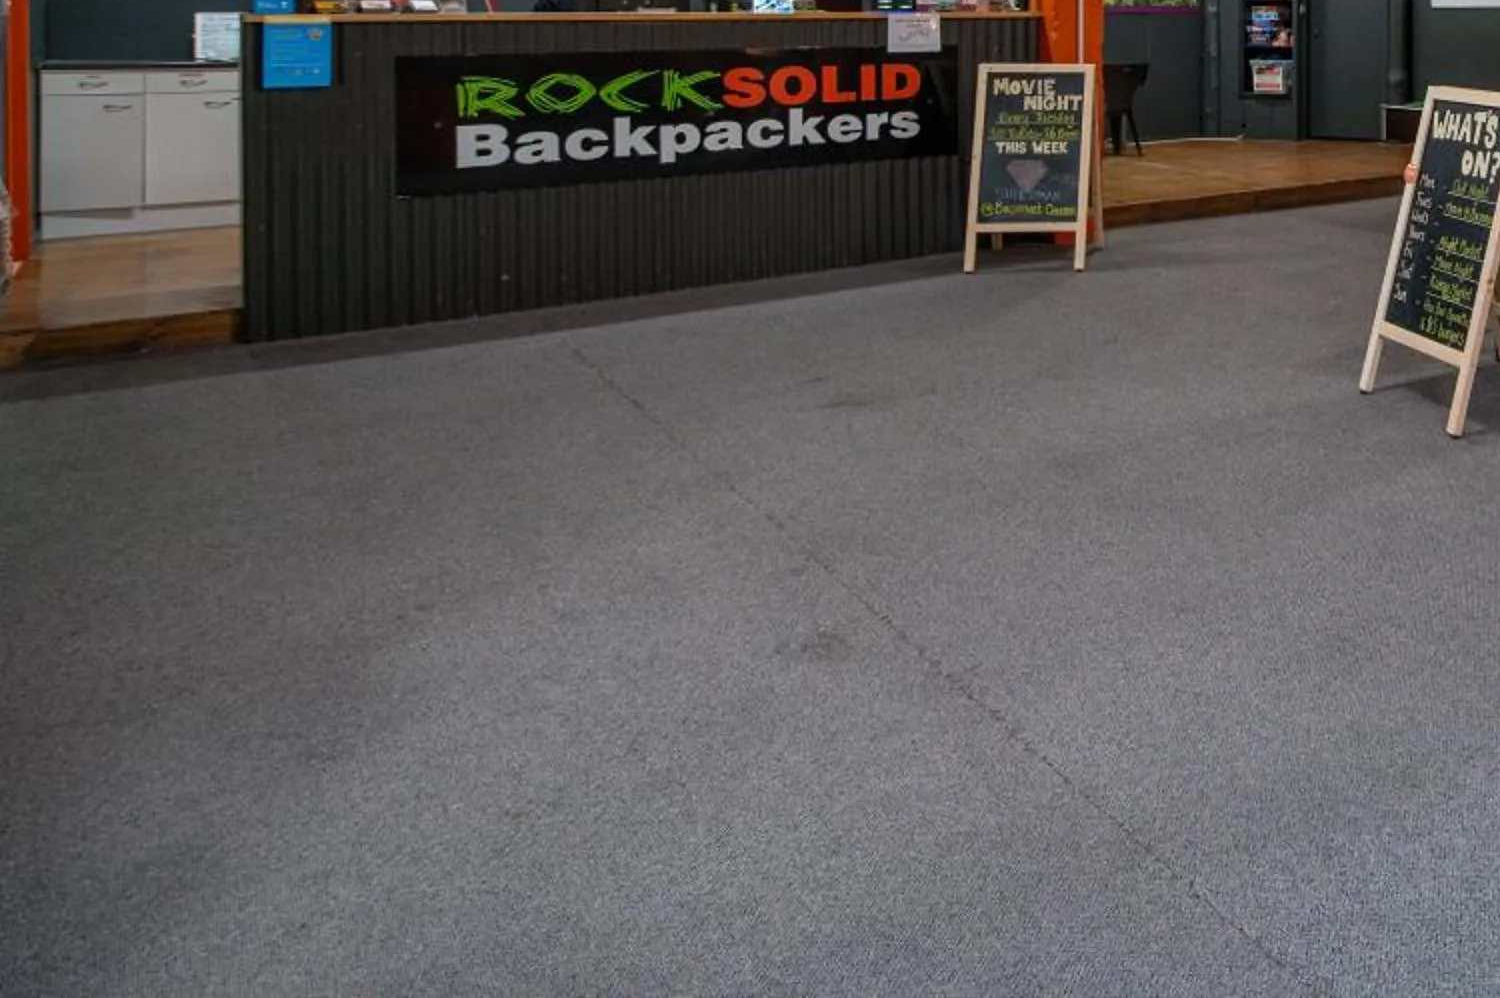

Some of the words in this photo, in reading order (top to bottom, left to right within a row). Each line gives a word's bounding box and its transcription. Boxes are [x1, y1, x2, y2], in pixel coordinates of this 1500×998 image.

[1023, 95, 1083, 111] NIGHT
[456, 108, 921, 169] Backpackers
[1432, 109, 1499, 149] WHAT'S
[995, 141, 1027, 154] THIS
[1032, 141, 1068, 154] WEEK
